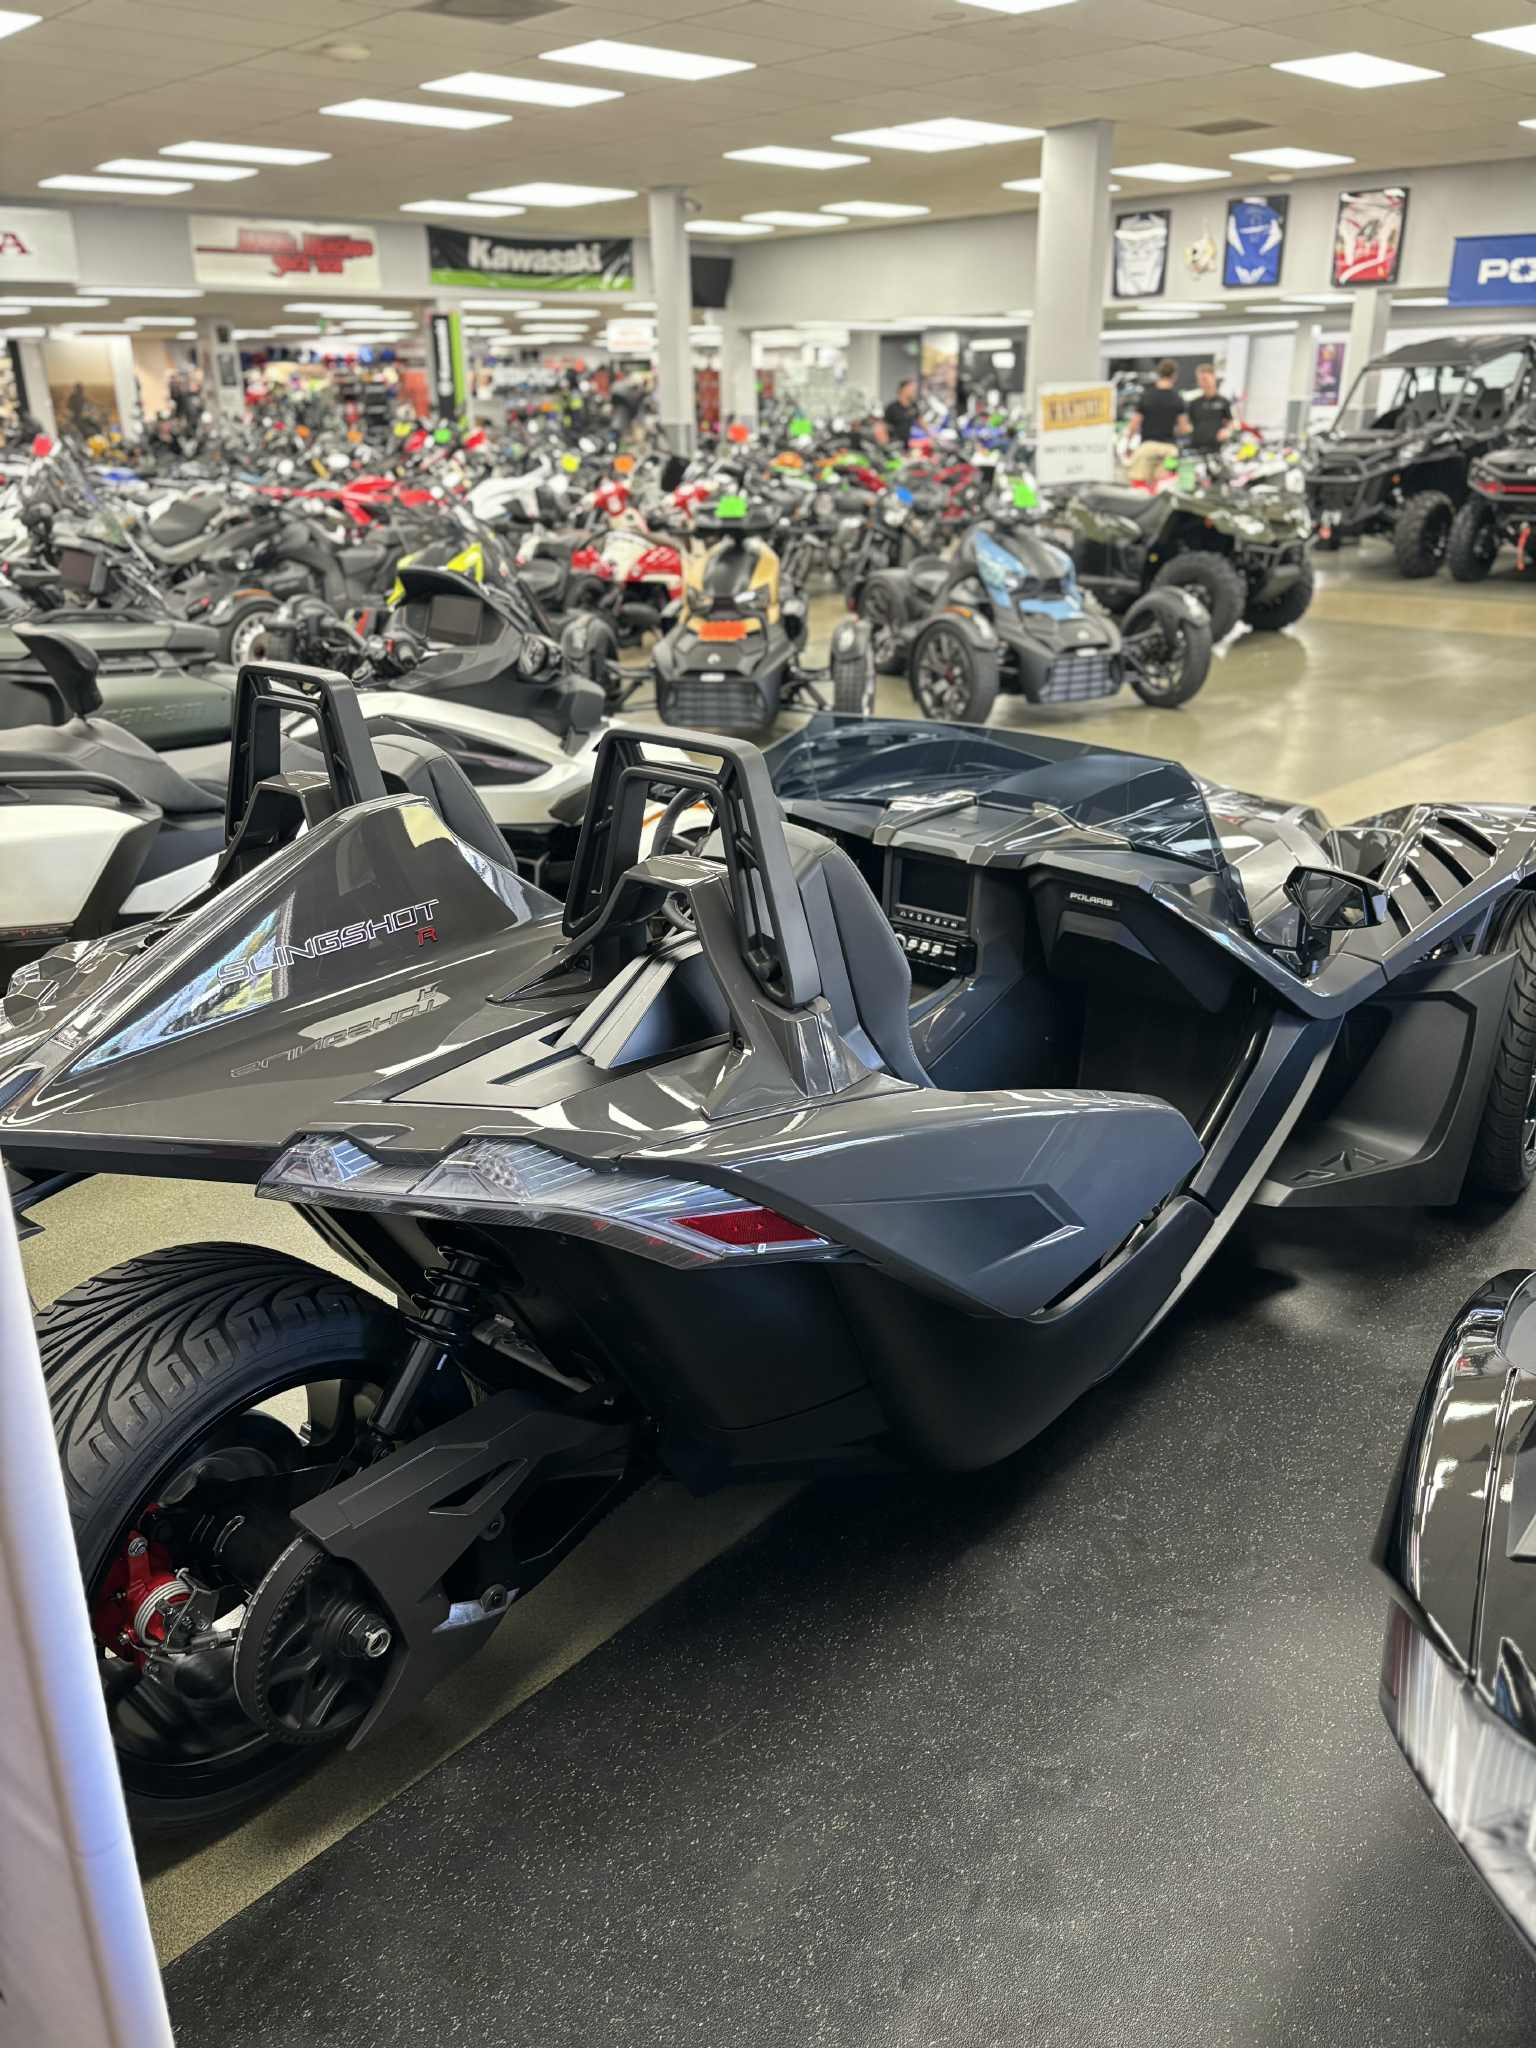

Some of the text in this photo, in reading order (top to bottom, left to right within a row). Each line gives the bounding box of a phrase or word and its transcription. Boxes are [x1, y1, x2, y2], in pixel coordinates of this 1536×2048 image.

[468, 238, 602, 273] Kawasaki
[1069, 892, 1113, 906] POLARIS
[217, 899, 439, 986] SLINGSHOT
[417, 926, 438, 946] R
